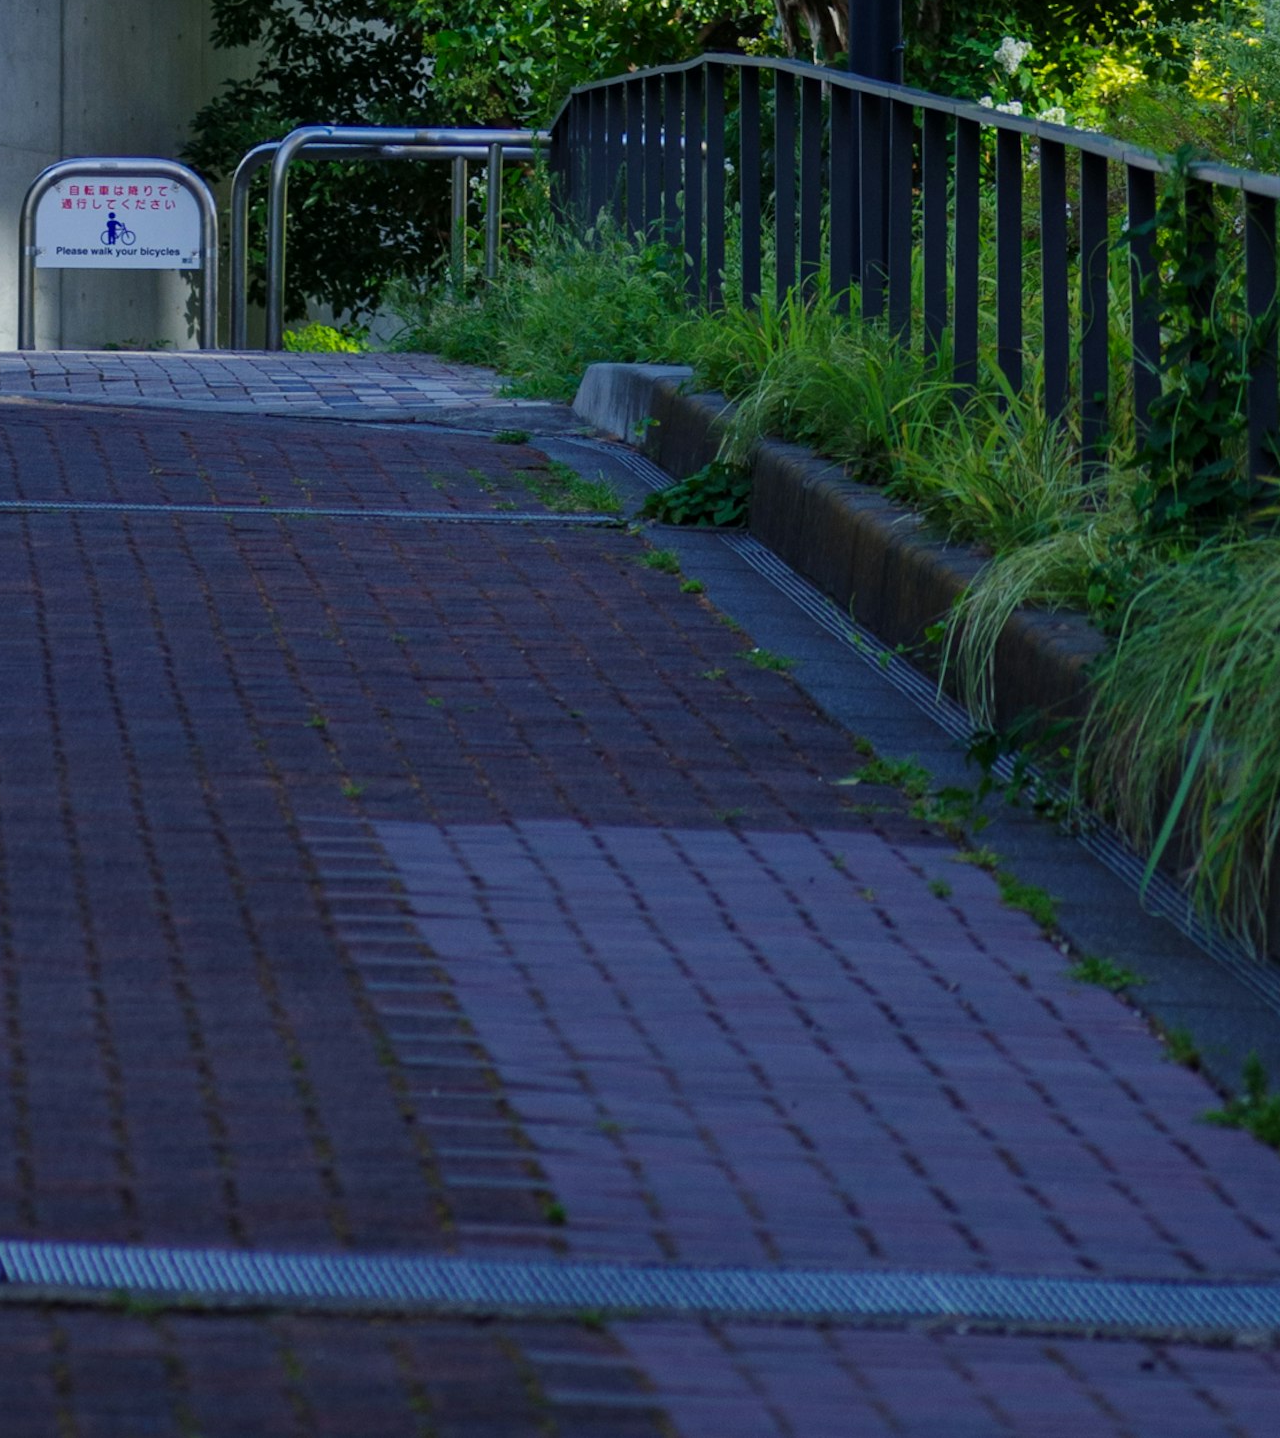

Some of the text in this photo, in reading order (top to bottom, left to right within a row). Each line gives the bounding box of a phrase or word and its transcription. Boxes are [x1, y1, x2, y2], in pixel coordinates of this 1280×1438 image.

[69, 185, 169, 197] 自転車は降りて
[61, 198, 176, 210] 通行してください
[56, 246, 180, 257] Please walk your bicycles
